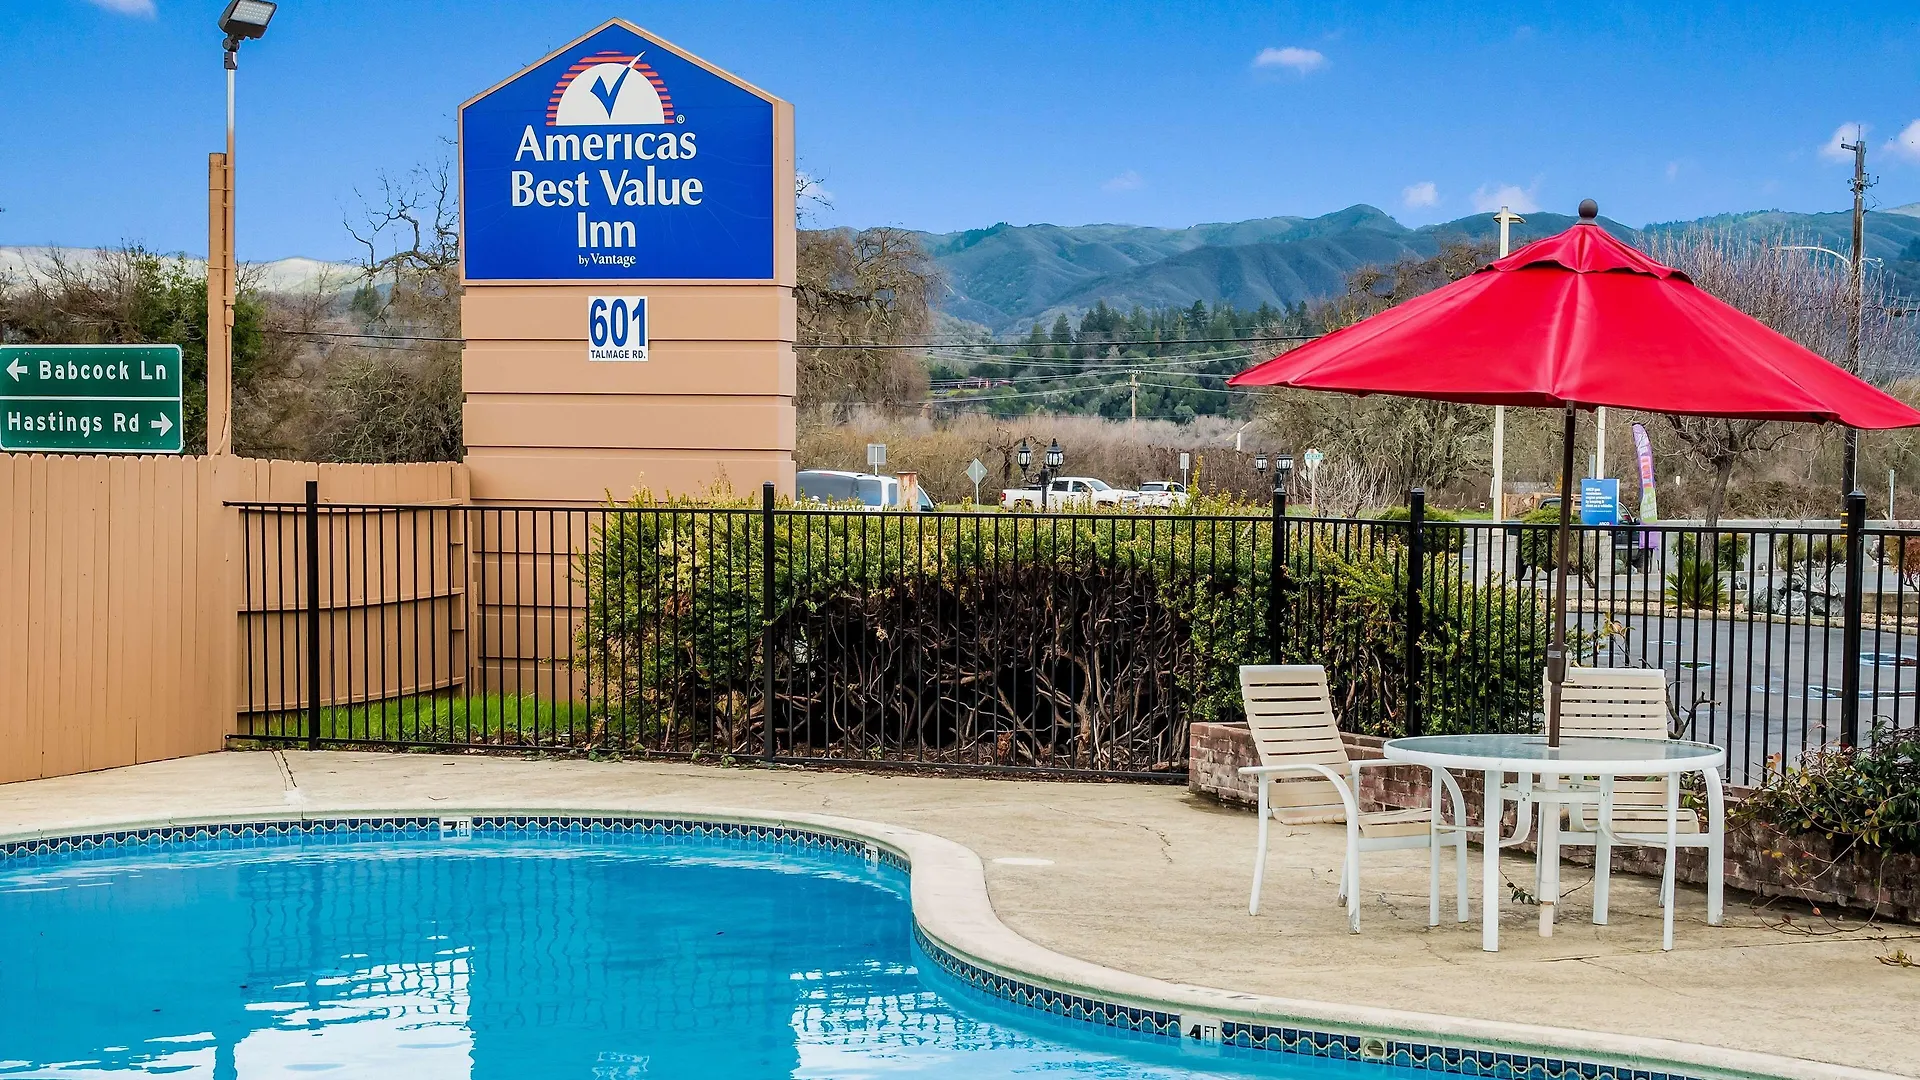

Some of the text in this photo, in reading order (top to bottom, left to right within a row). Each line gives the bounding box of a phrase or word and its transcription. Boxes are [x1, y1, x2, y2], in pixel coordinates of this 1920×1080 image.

[514, 124, 698, 162] Americas
[511, 165, 703, 207] Best Value
[577, 211, 637, 248] Inn
[578, 253, 637, 268] by Vantage
[589, 298, 646, 348] 601
[590, 350, 646, 359] TALMAGE RD.
[39, 360, 167, 381] Babcock Ln
[7, 411, 139, 438] Hastings Rd
[459, 821, 469, 829] FT
[1185, 1024, 1217, 1041] 4 FT
